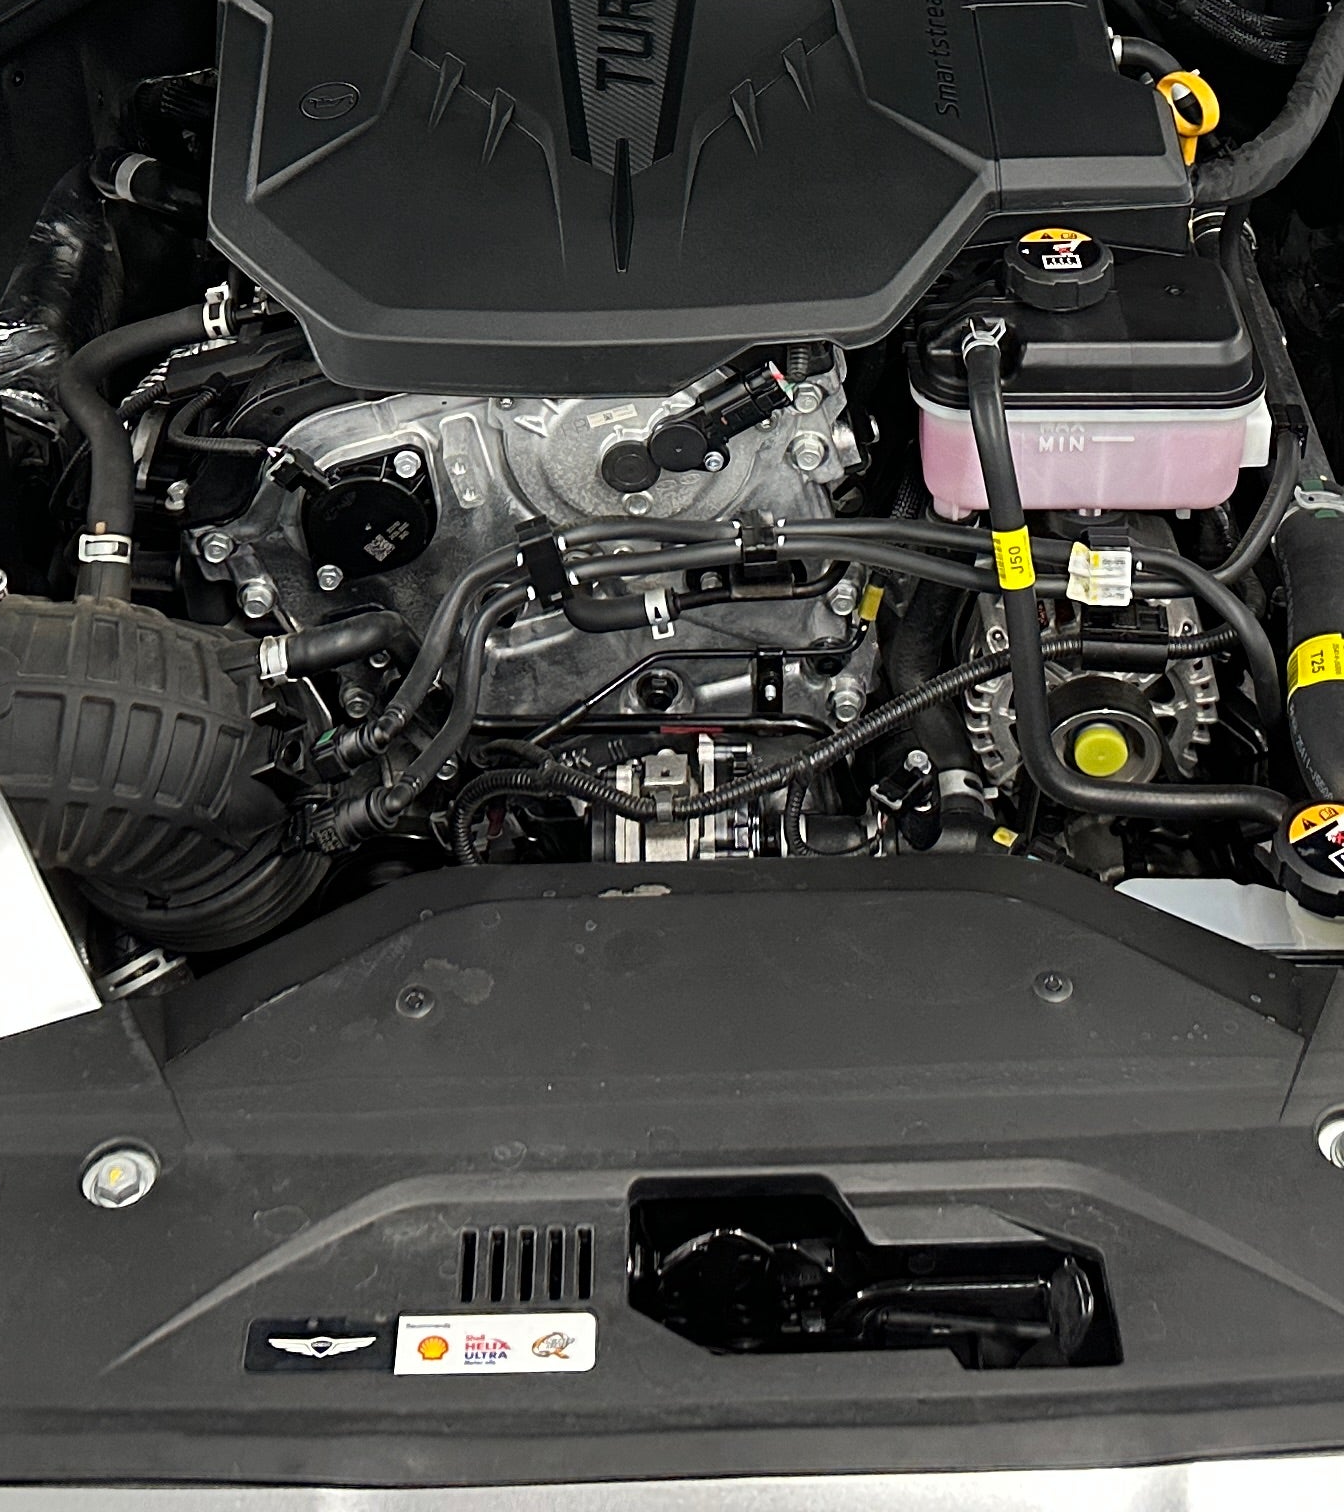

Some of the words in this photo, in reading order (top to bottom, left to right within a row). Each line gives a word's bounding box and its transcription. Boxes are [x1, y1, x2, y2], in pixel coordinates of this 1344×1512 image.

[1039, 435, 1085, 453] MIN
[1008, 546, 1024, 574] J50
[1311, 649, 1325, 674] T25
[464, 1342, 512, 1351] HELIX
[464, 1351, 508, 1360] ULTRA
